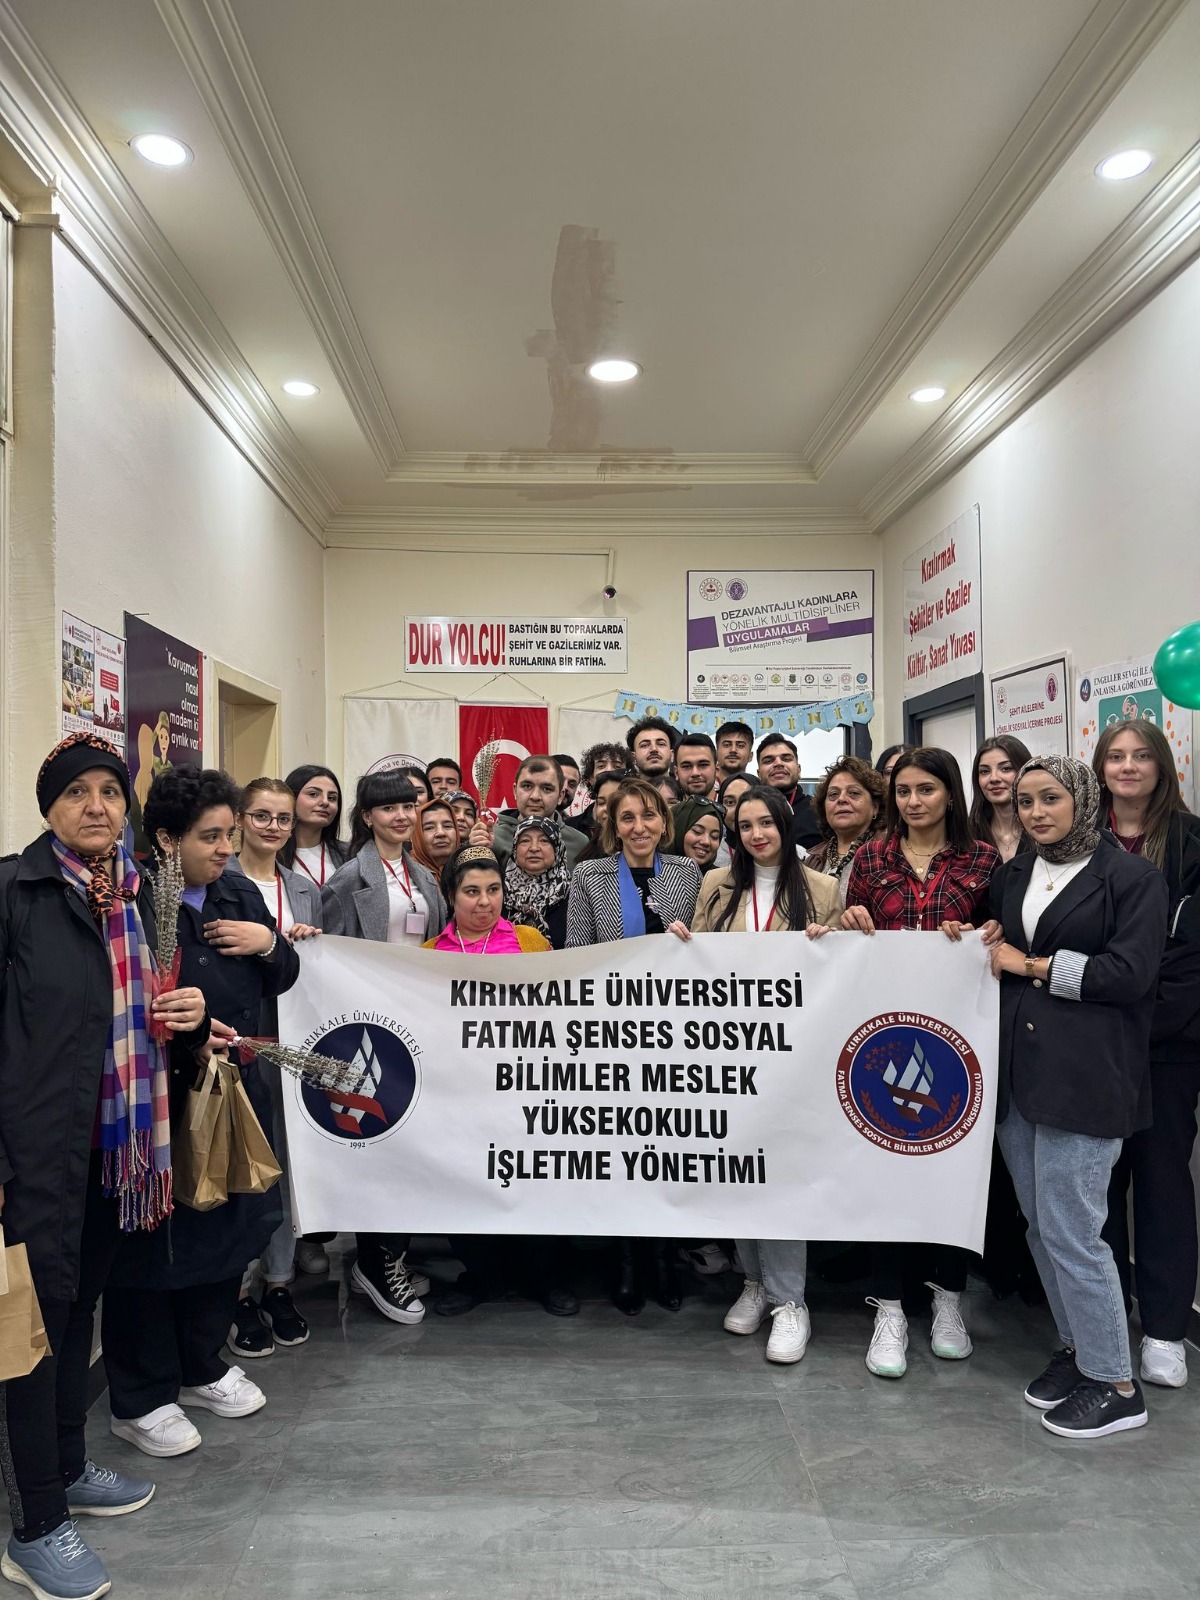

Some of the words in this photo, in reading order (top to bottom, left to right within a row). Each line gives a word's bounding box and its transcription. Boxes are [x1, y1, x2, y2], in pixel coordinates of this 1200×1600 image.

[921, 538, 956, 584] Kızılırmak
[721, 600, 796, 620] DEZAVANTAJLI
[797, 590, 858, 608] KADINLARA
[722, 616, 769, 632] YÖNELİK
[770, 601, 861, 625] MULTİDİSİPLİNER
[909, 601, 935, 642] Şehitler
[935, 599, 944, 621] ve
[945, 579, 972, 615] Gaziler
[508, 622, 548, 634] BASTIĞIN
[550, 624, 562, 634] BU
[563, 624, 624, 634] TOPRAKLARDA
[726, 622, 810, 644] UYGULAMALAR
[408, 623, 443, 665] DUR
[447, 623, 506, 666] YOLCU!
[508, 638, 533, 652] ŞEHİT
[535, 640, 547, 650] VE
[548, 638, 602, 650] GAZİLERİMİZ
[603, 641, 622, 650] VAR.
[728, 644, 752, 653] Bilimsel
[752, 639, 782, 650] Araştırma
[782, 636, 803, 646] Projesi
[907, 649, 928, 680] Kültür,
[929, 638, 949, 670] Sanat
[950, 630, 976, 660] Yuvası
[508, 656, 557, 666] RUHLARINA
[559, 654, 573, 666] BİR
[575, 655, 606, 667] FATİHA.
[1093, 672, 1122, 686] ENGELLER
[1122, 667, 1139, 680] SEVGİ
[1139, 665, 1149, 676] İLE
[185, 682, 199, 697] nasıl
[181, 697, 199, 715] olmaz
[1044, 713, 1063, 727] PROJESİ
[169, 712, 193, 730] madem
[193, 718, 199, 732] ki
[450, 979, 595, 1007] KIRIKKALE
[605, 972, 803, 1008] ÜNİVERSİTESİ
[300, 1013, 349, 1051] IRIKKALE
[353, 1010, 424, 1057] ÜNİVERSİTESİ
[462, 1020, 557, 1049] FATMA
[566, 1020, 673, 1056] ŞENSES
[684, 1021, 793, 1052] SOSYAL
[845, 1014, 895, 1054] KIRIKKALE
[898, 1012, 973, 1056] ÜNİVERSİTESİ
[496, 1055, 630, 1092] BİLİMLER
[642, 1063, 758, 1096] MESLEK
[838, 1069, 848, 1101] FATMA
[841, 1100, 867, 1129] ŞENSES
[961, 1073, 983, 1131] YÜKSEKOKULU
[522, 1099, 728, 1139] YÜKSEKOKULU
[862, 1126, 892, 1149] SOSYAL
[894, 1142, 934, 1153] BİLİMLER
[935, 1129, 964, 1150] MESLEK
[487, 1143, 611, 1188] İŞLETME
[621, 1144, 766, 1184] YÖNETİMİ
